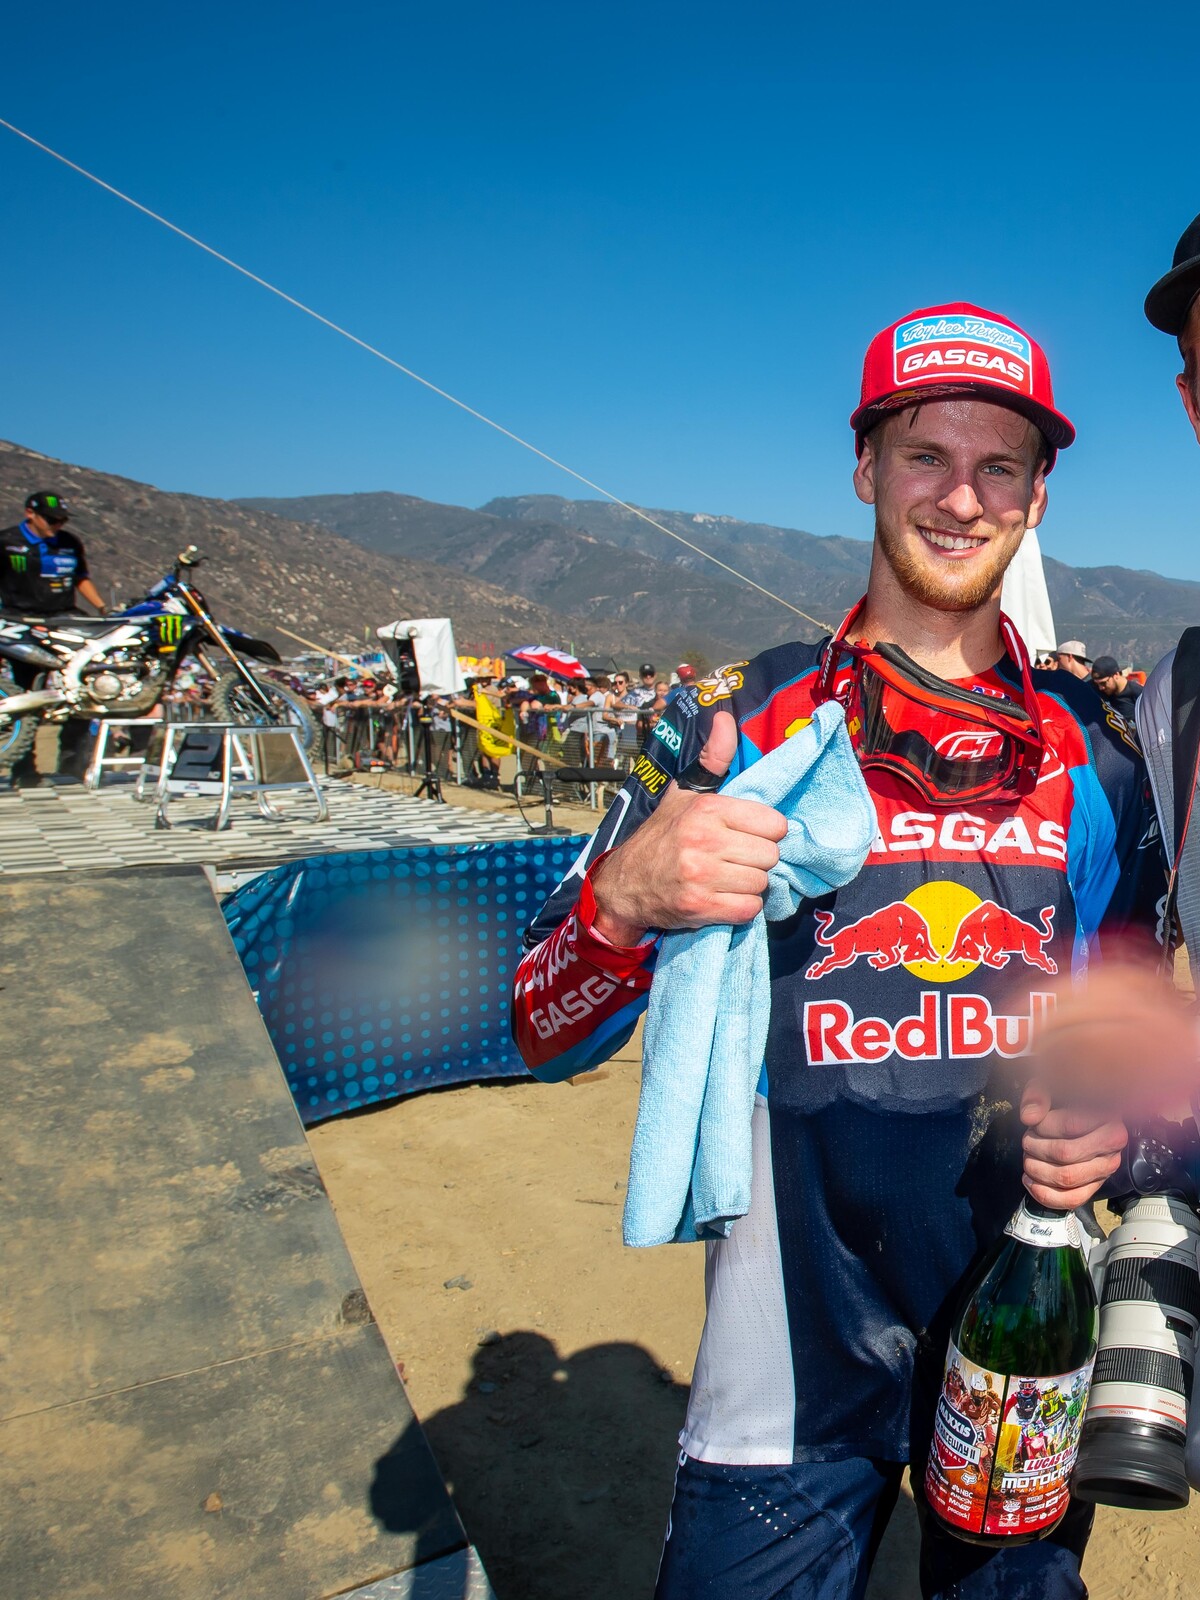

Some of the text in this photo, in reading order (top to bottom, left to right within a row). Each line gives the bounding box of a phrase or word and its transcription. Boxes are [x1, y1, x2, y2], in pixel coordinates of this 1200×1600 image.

[902, 319, 1024, 352] Troy Lee Designs
[902, 349, 1024, 382] GASGAS
[171, 733, 222, 778] 2
[804, 990, 941, 1066] Red
[940, 1401, 972, 1438] MAXXIS
[1027, 1454, 1060, 1471] LUCAS
